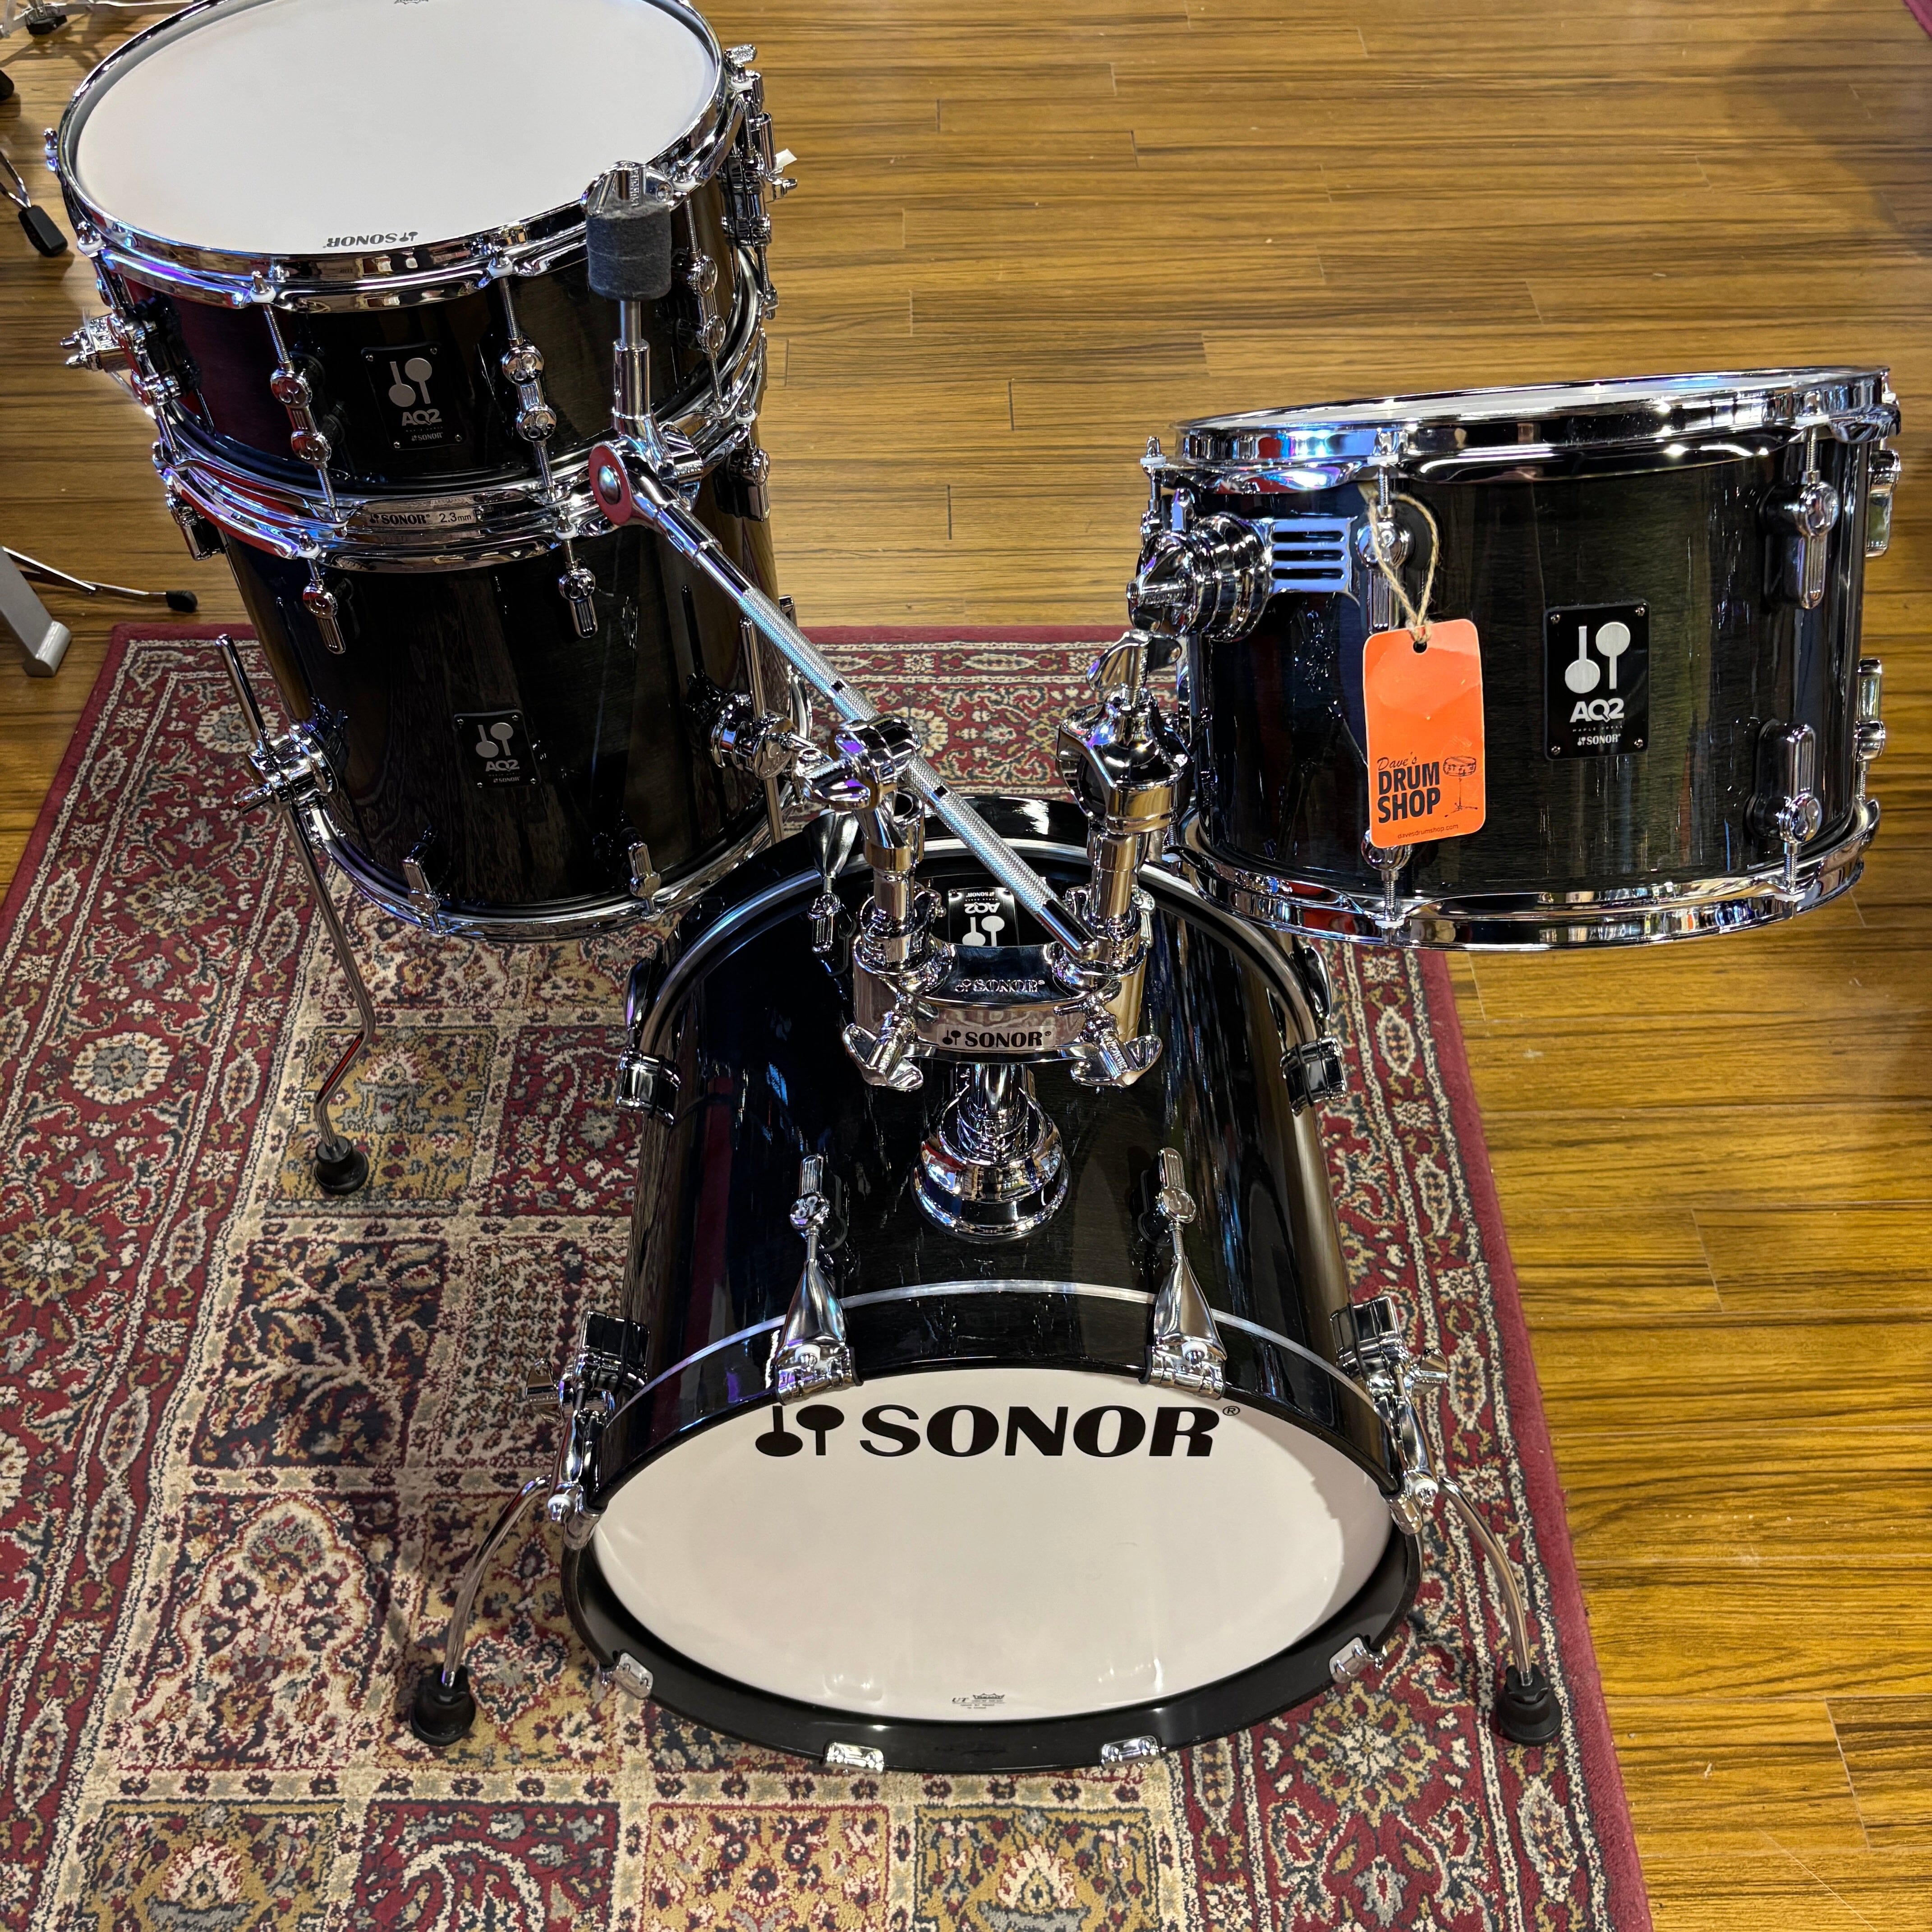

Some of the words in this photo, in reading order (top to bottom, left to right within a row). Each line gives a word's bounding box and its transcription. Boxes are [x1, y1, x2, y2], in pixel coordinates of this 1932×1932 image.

[323, 233, 398, 248] SONOR
[401, 409, 442, 426] AQ2
[439, 512, 472, 523] 2.3mm
[1569, 698, 1624, 722] AQ2
[485, 759, 520, 772] AQ2
[1377, 751, 1417, 771] Dave's
[1378, 761, 1440, 796] DRUM
[1377, 787, 1441, 823] SHOP
[1397, 823, 1459, 839] davesdrumshop.com
[964, 902, 1000, 914] AQ2
